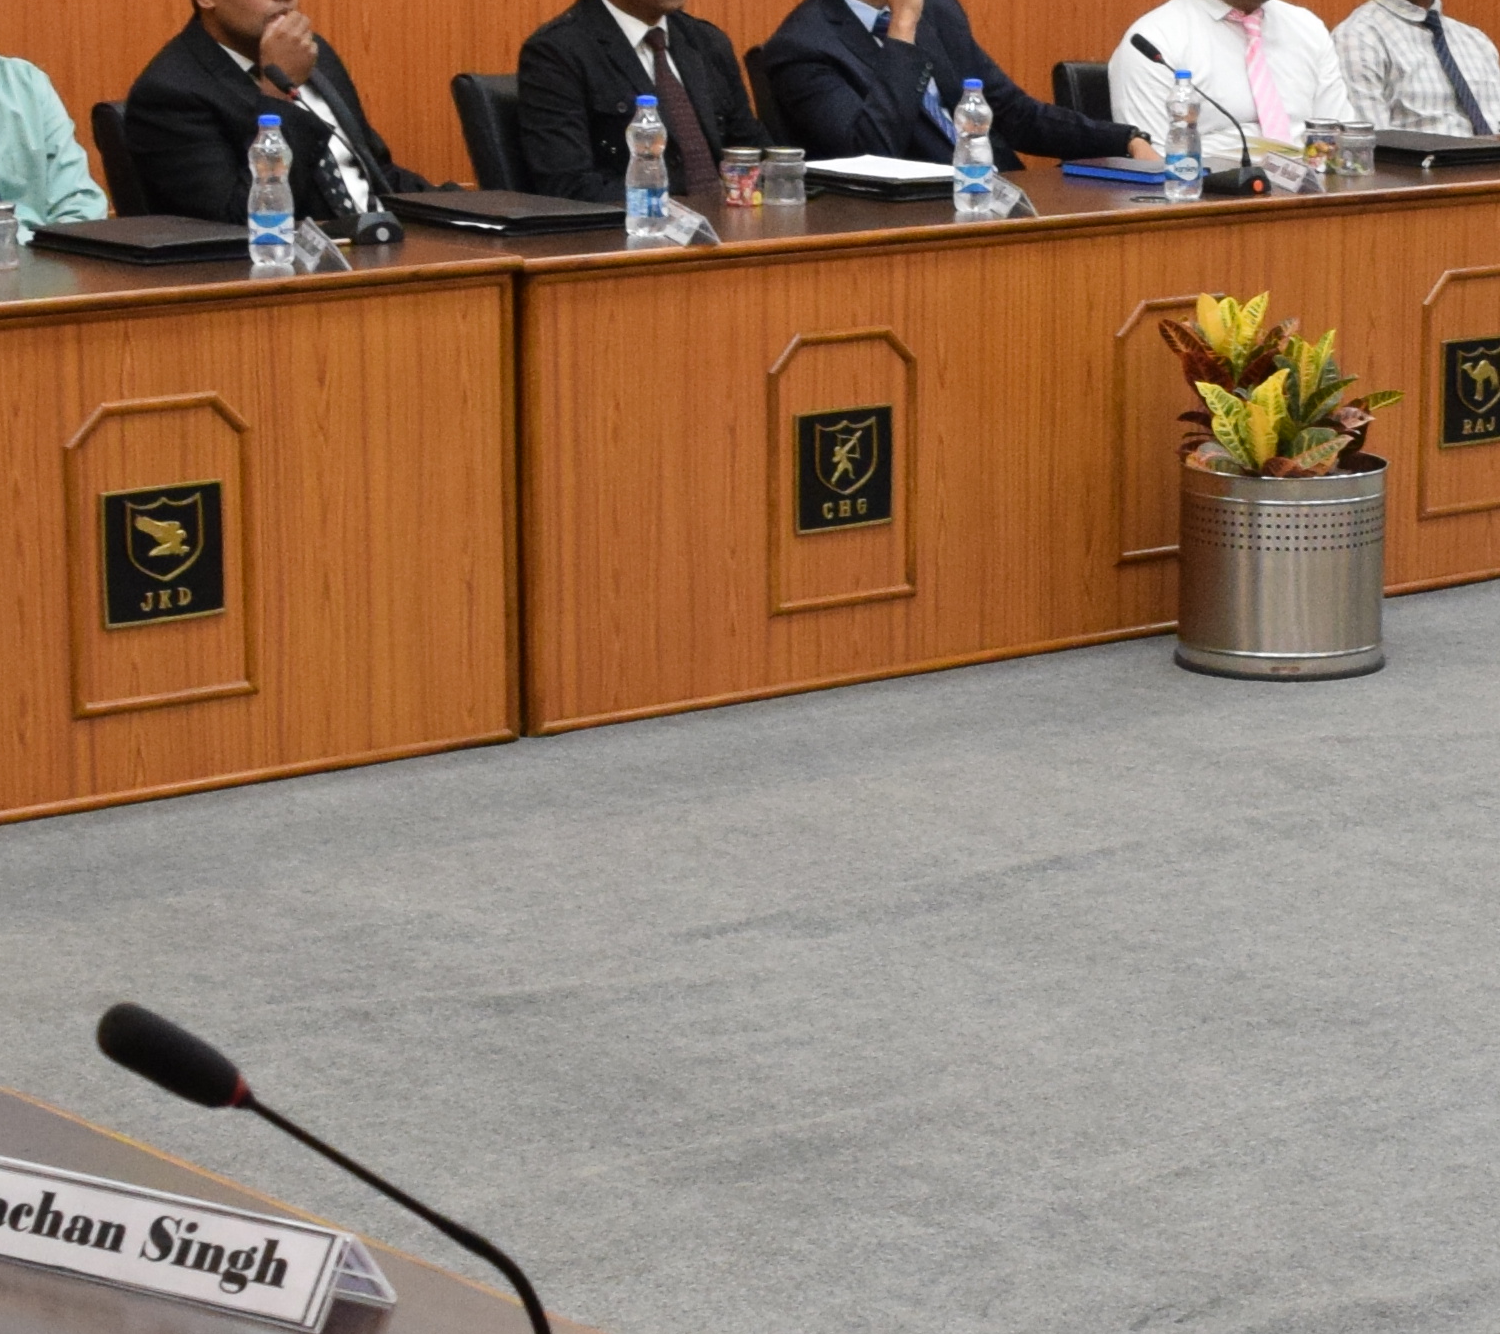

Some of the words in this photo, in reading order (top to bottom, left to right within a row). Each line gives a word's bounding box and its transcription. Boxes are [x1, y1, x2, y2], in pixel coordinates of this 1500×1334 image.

[1461, 416, 1496, 435] RAJ
[821, 497, 868, 520] CHG
[139, 587, 193, 612] JKD
[138, 1213, 290, 1295] Singh
